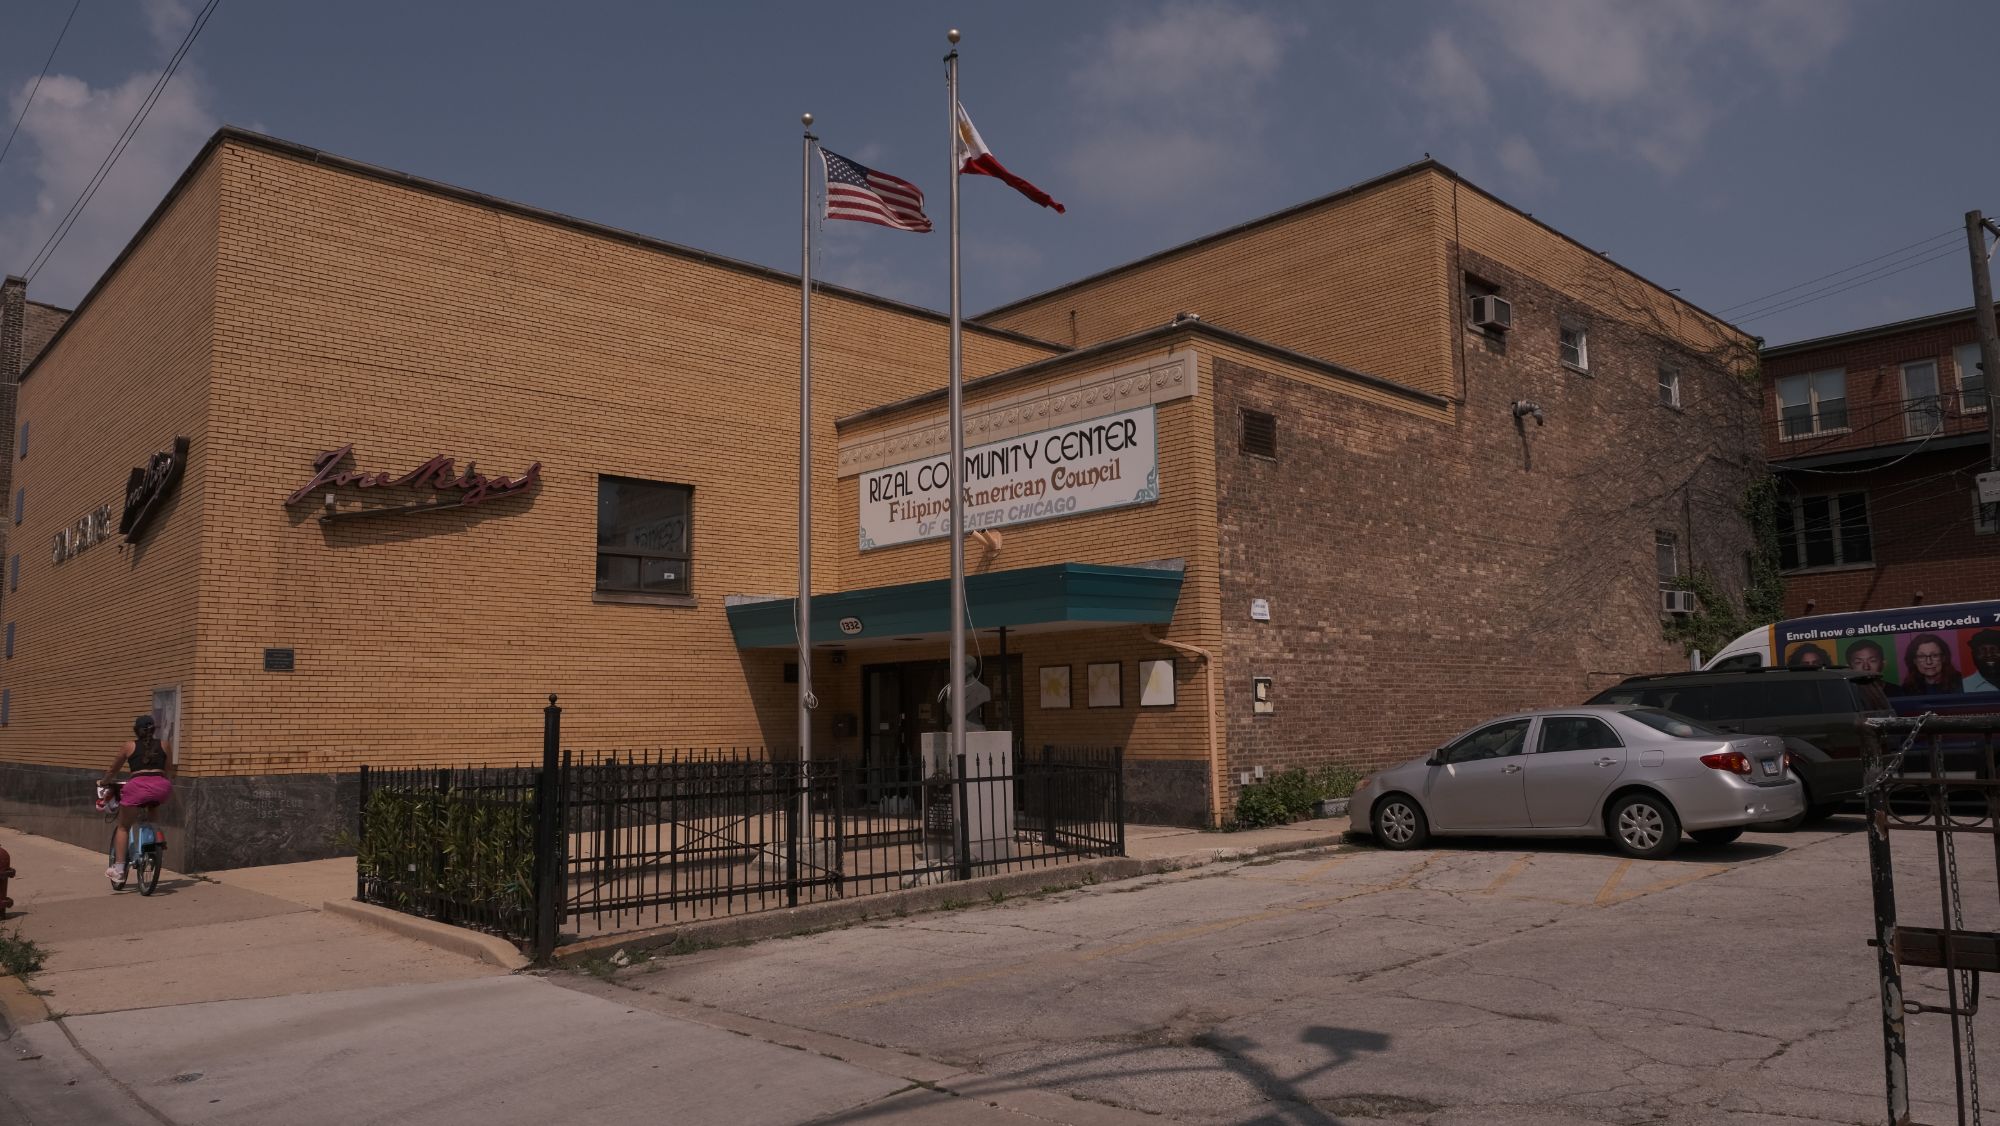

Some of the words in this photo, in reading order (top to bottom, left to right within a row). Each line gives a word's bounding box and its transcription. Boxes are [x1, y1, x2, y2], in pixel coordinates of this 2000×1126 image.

[869, 471, 913, 503] RIZAL
[917, 440, 1038, 491] COMUNITY
[1045, 418, 1137, 464] CENTER
[889, 497, 951, 523] Filipino
[962, 477, 1046, 507] American
[1051, 458, 1121, 490] Council
[918, 520, 936, 536] OF
[940, 509, 1004, 532] GEATER
[1008, 496, 1076, 521] CHICAGO
[842, 620, 860, 631] 1332
[1786, 629, 1817, 641] Enroll
[1820, 628, 1843, 638] now
[1846, 627, 1855, 636] @
[1858, 615, 1980, 635] allofus.uchicago.edu
